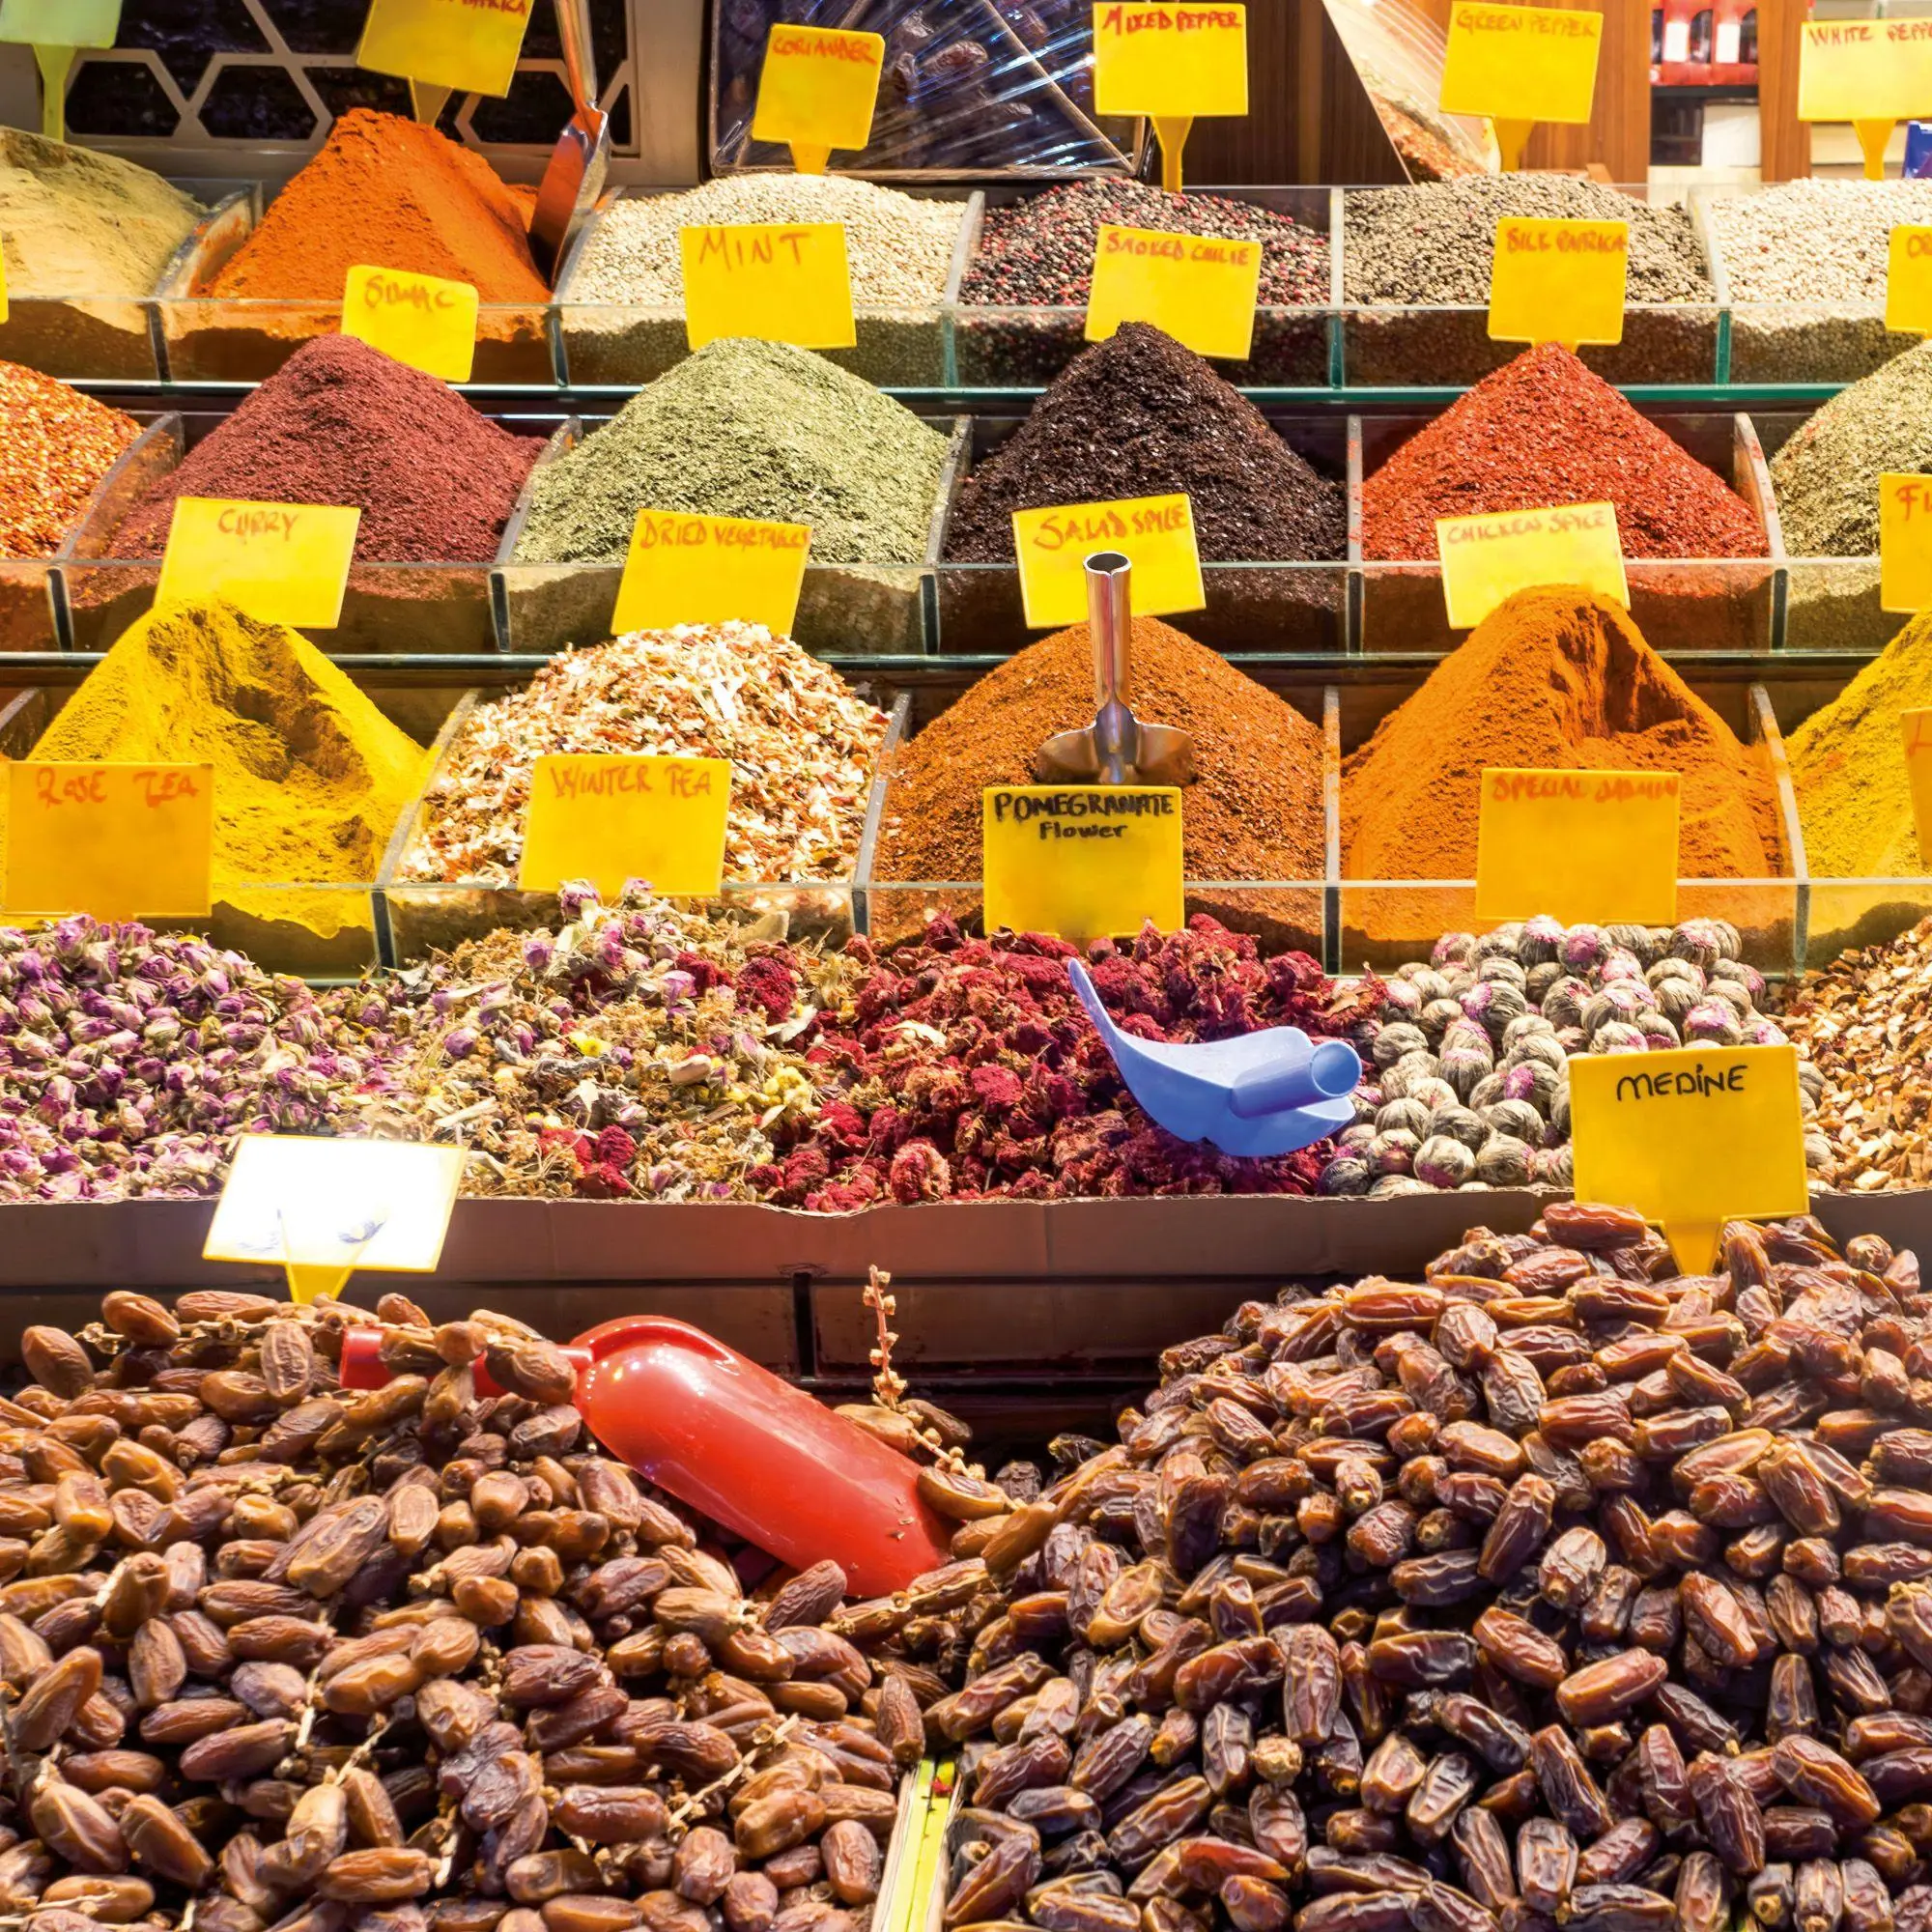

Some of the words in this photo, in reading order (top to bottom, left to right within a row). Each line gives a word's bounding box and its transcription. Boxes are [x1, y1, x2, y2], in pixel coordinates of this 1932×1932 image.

[1102, 5, 1173, 35] MIXED
[1176, 9, 1241, 32] PEPPER
[1457, 9, 1522, 35] GREEN
[1530, 14, 1596, 37] PEPPER
[1809, 26, 1873, 46] WHITE
[698, 227, 811, 271] MINT
[217, 507, 298, 545] CURRY
[639, 516, 707, 550] DRIED
[1034, 510, 1127, 550] SALAD
[1447, 517, 1543, 544] CHICKEN
[132, 770, 199, 808] TEA
[550, 763, 653, 799] WINTER
[664, 763, 711, 799] TEA
[994, 792, 1175, 822] POMEGRANATE
[1039, 821, 1128, 839] Flower
